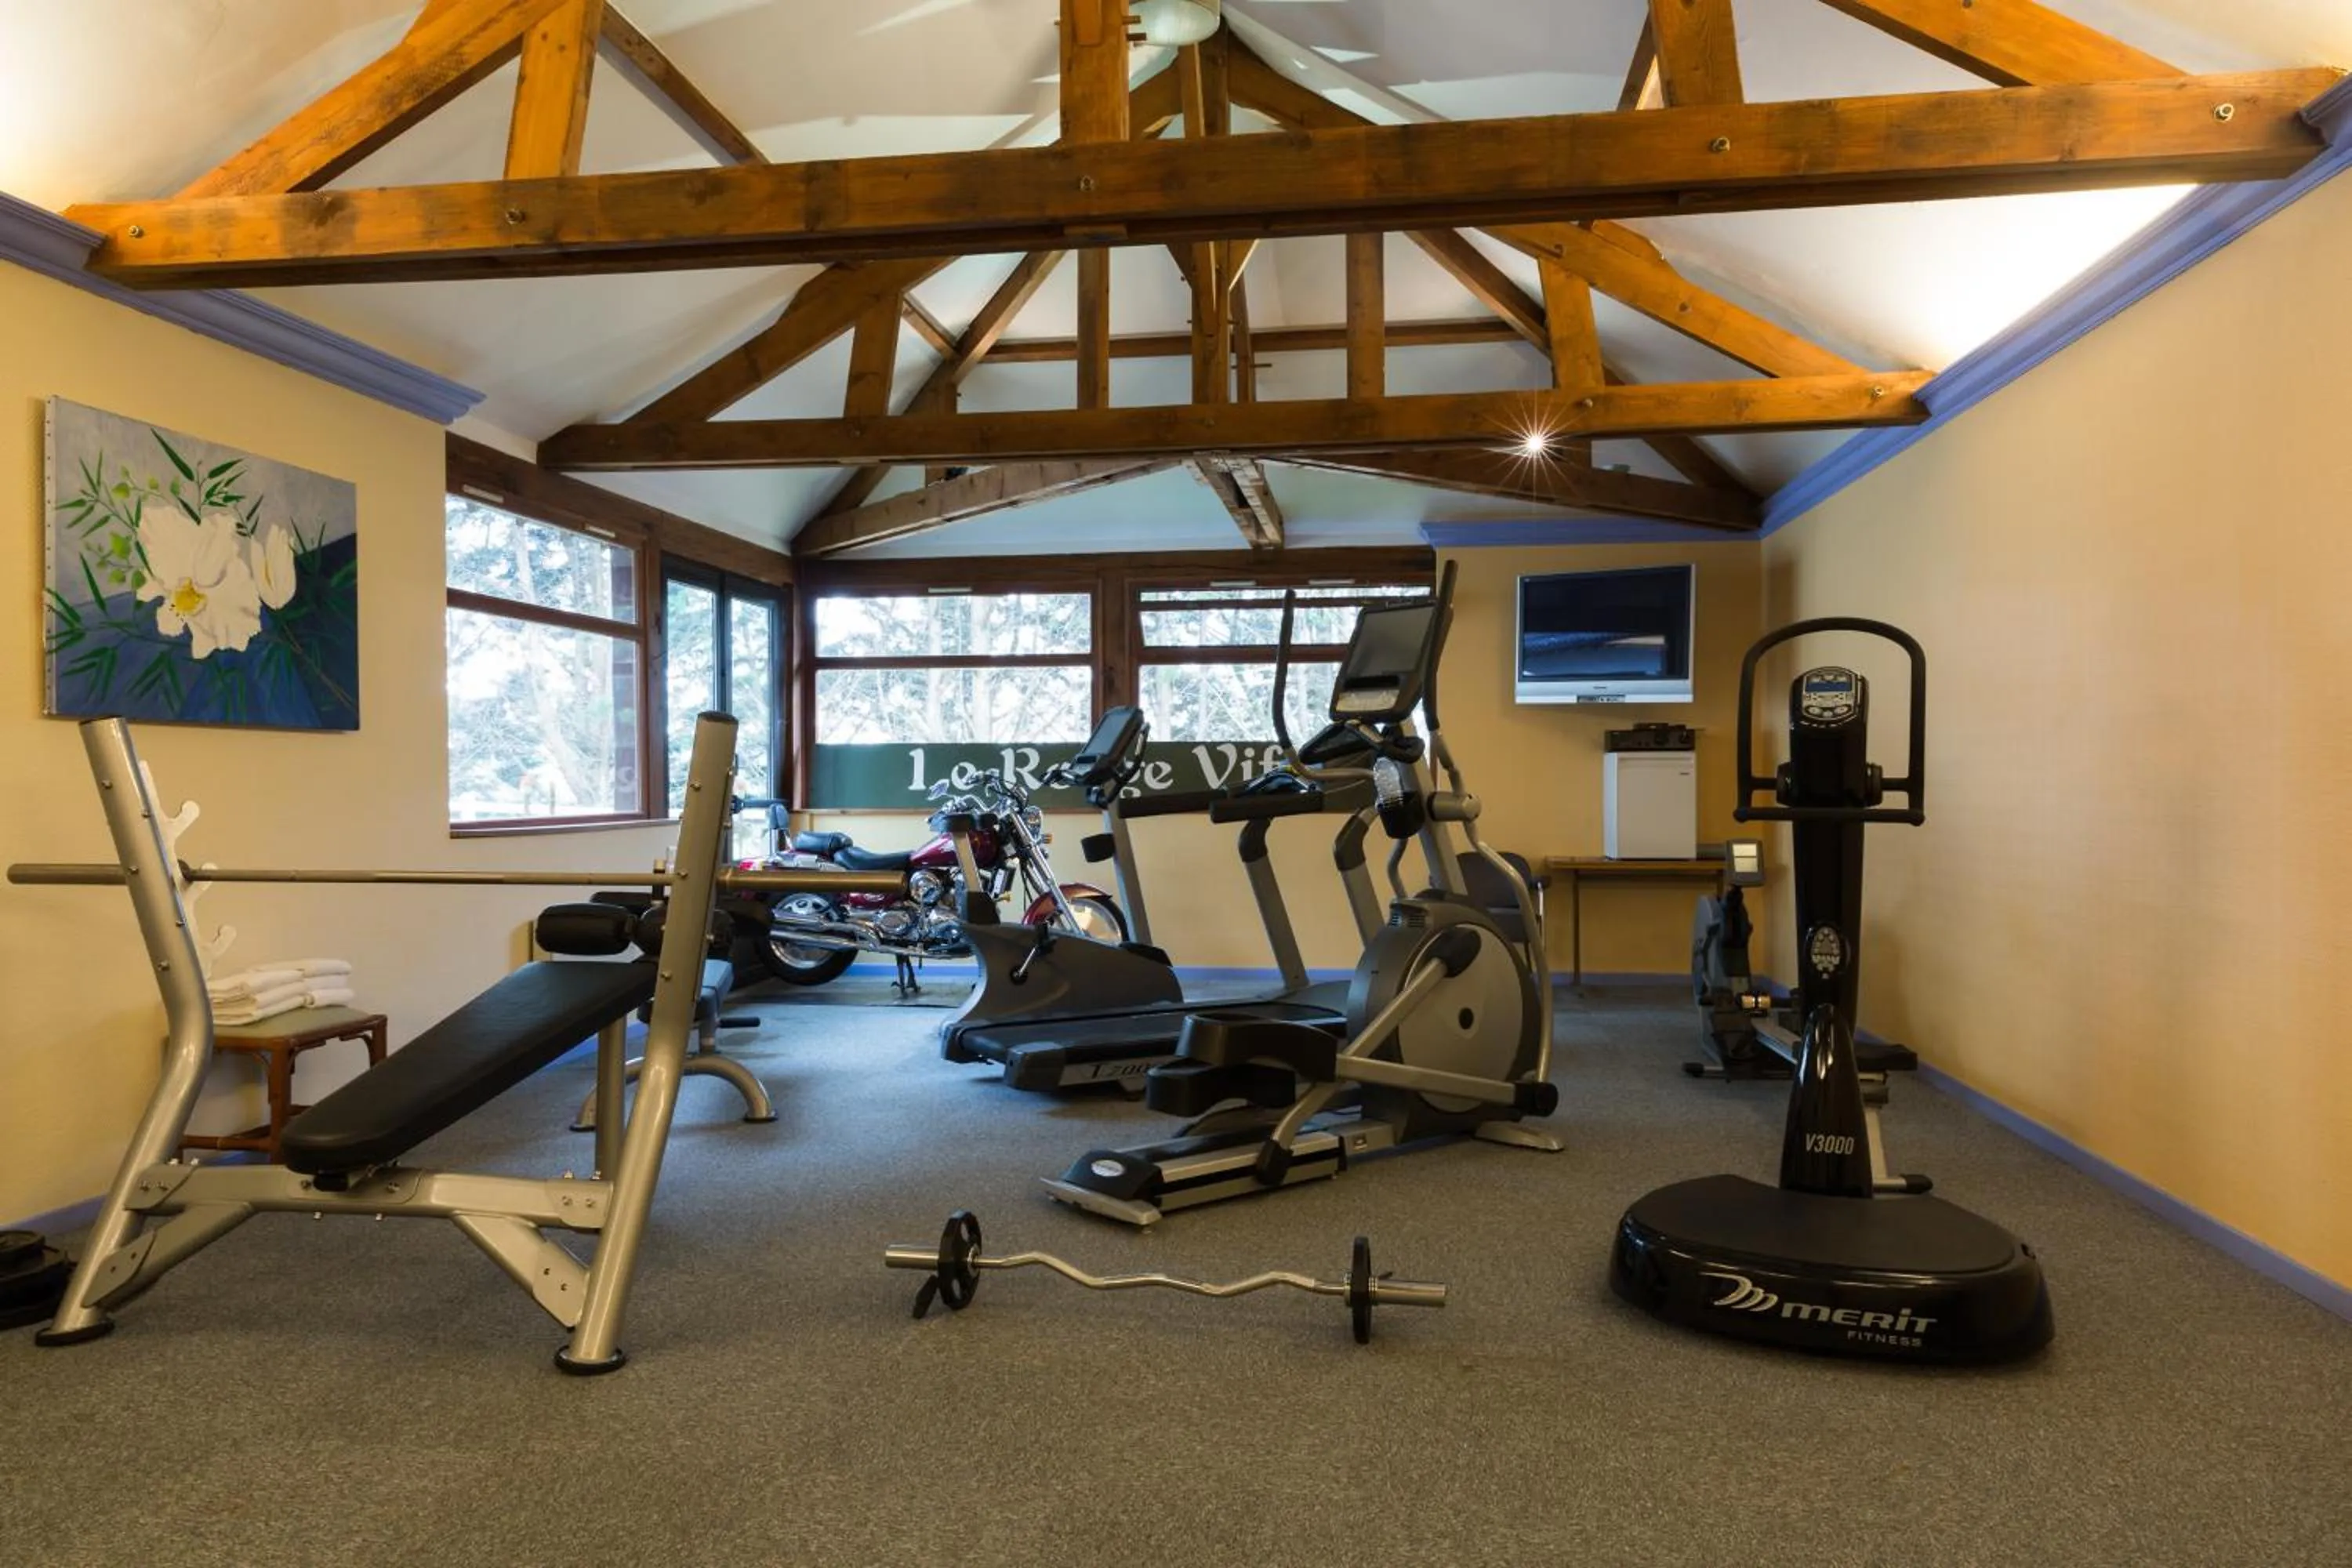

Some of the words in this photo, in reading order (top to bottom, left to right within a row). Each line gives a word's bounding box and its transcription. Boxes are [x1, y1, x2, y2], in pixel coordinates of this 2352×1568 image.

[1192, 743, 1284, 789] Vif
[1806, 1133, 1855, 1155] V3000
[1846, 1330, 1922, 1348] FITNESS
